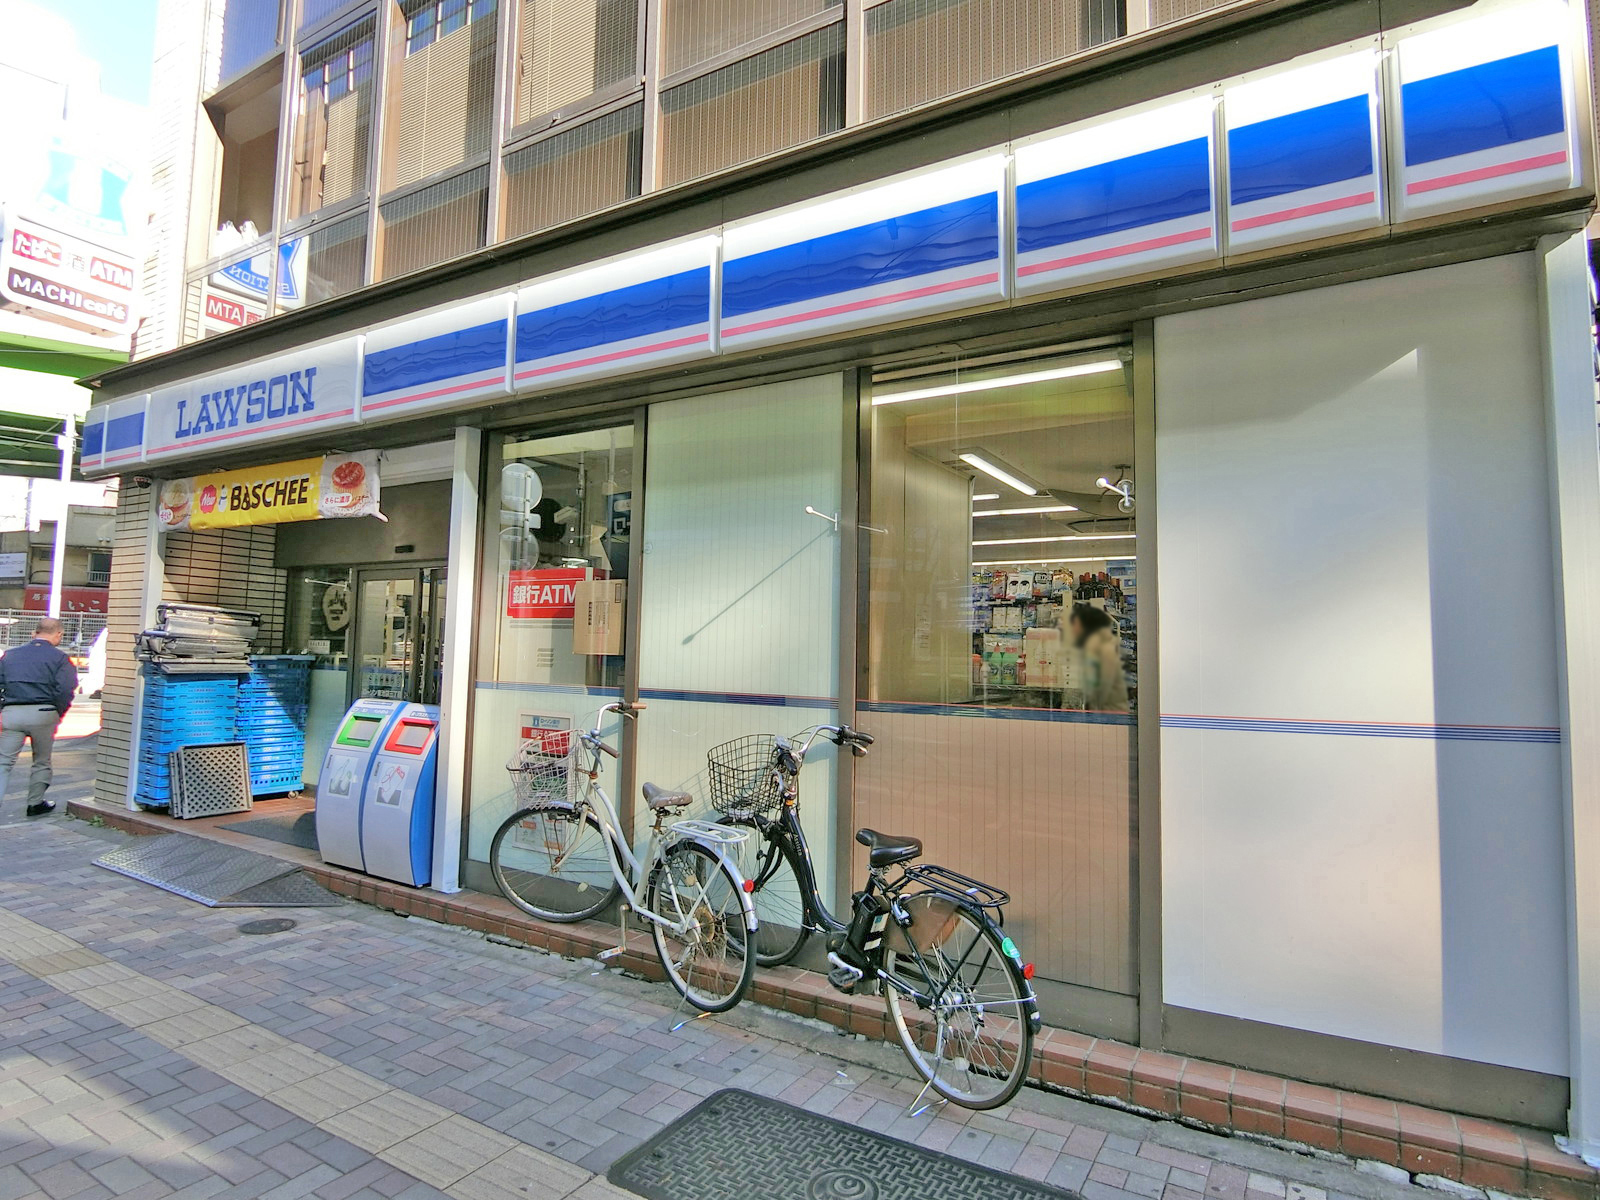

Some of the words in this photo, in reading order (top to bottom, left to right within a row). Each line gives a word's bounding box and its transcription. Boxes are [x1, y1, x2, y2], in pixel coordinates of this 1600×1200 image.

[15, 233, 62, 266] たばこ
[91, 260, 133, 289] ATM
[12, 273, 83, 308] MACHI
[175, 366, 318, 440] LAWSON
[201, 493, 216, 506] New
